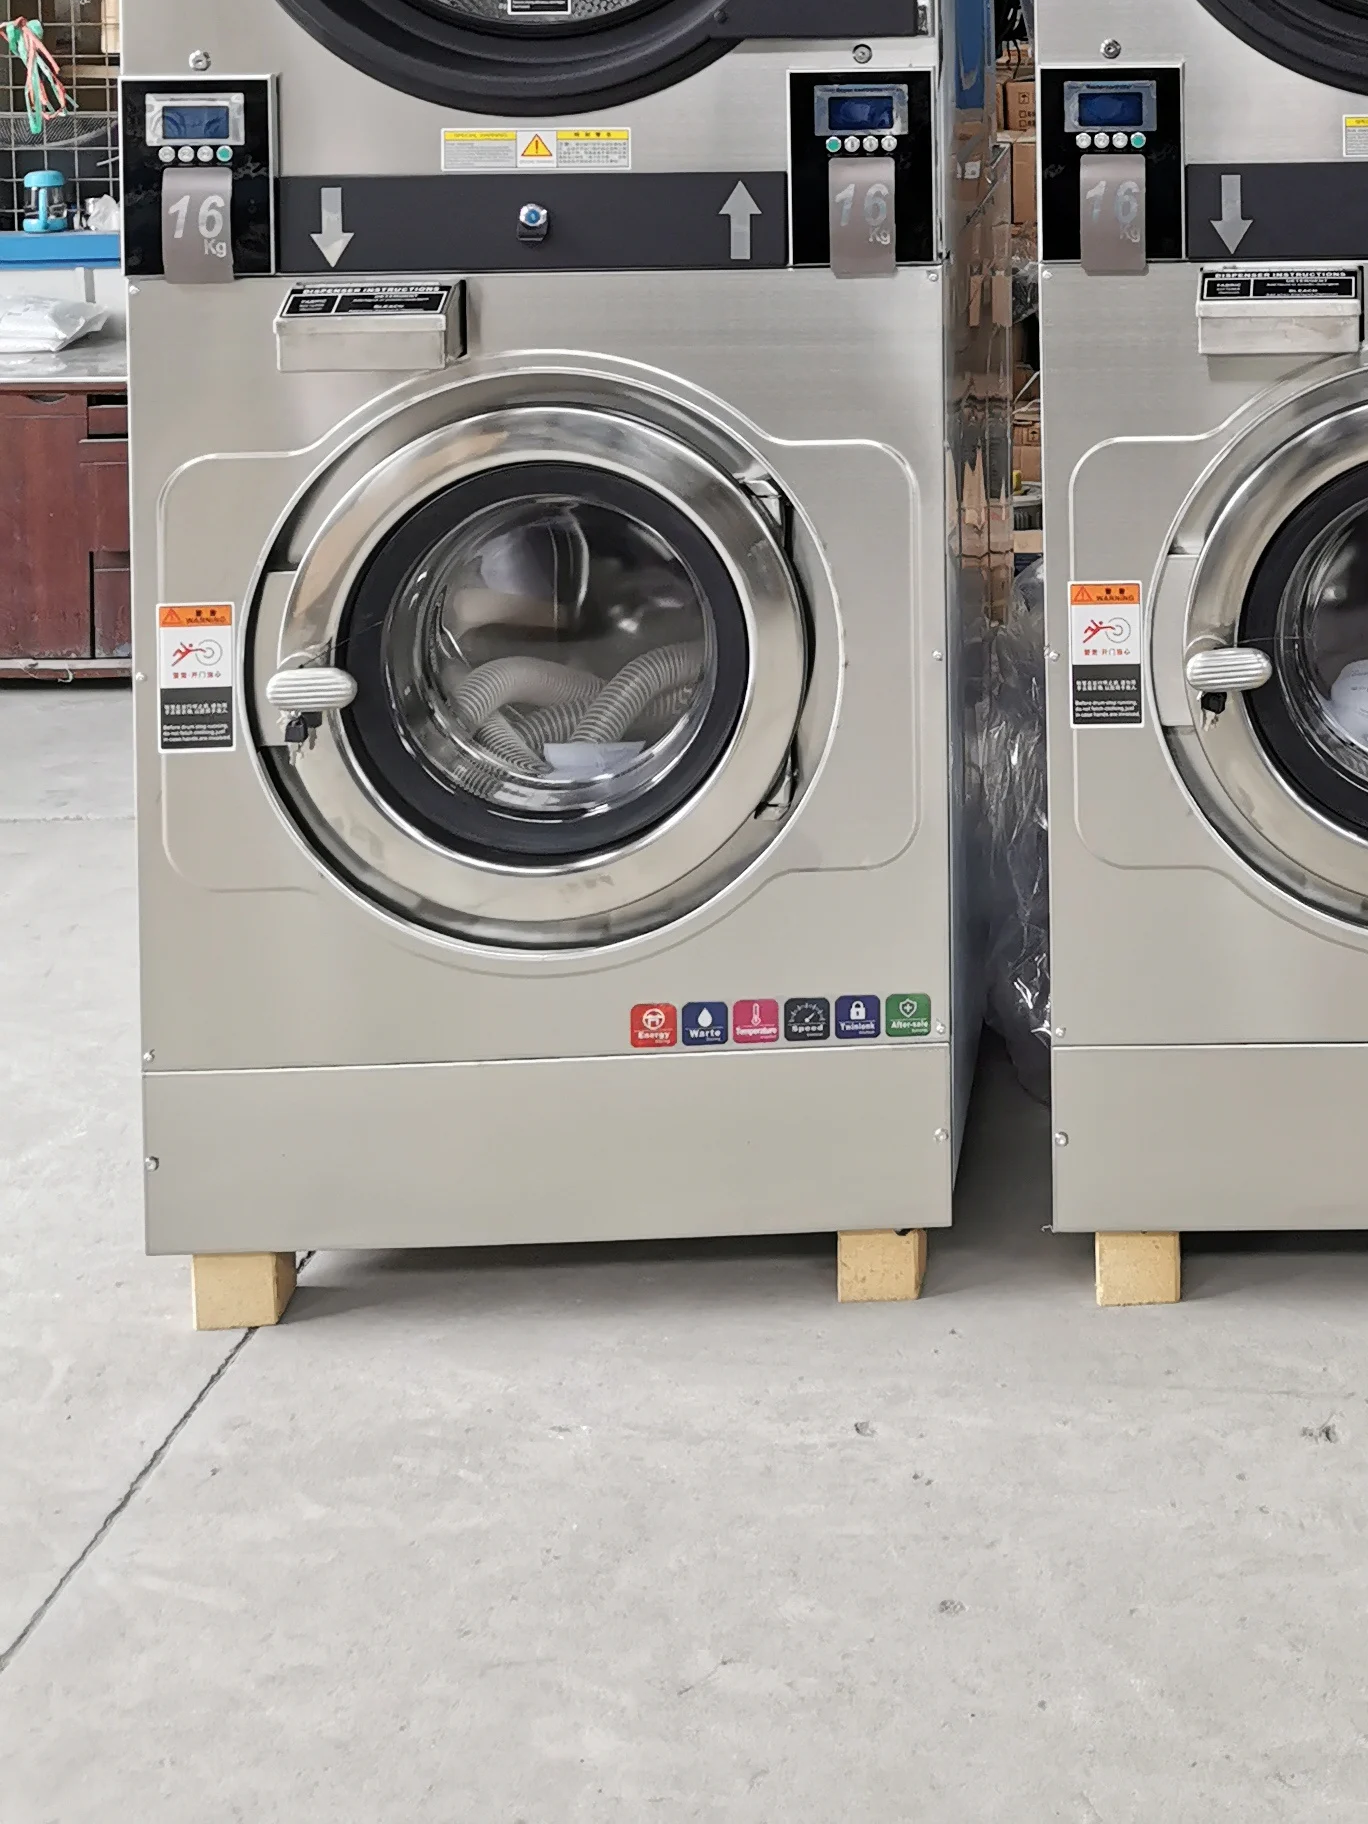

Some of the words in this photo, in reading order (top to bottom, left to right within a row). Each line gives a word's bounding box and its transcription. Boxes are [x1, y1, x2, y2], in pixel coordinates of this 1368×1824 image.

[834, 183, 889, 227] 16
[1086, 180, 1140, 223] 16
[168, 194, 225, 239] 16
[868, 226, 891, 245] Kg
[204, 239, 227, 258] Kg
[638, 1031, 670, 1040] Energy
[792, 1025, 823, 1033] Speed
